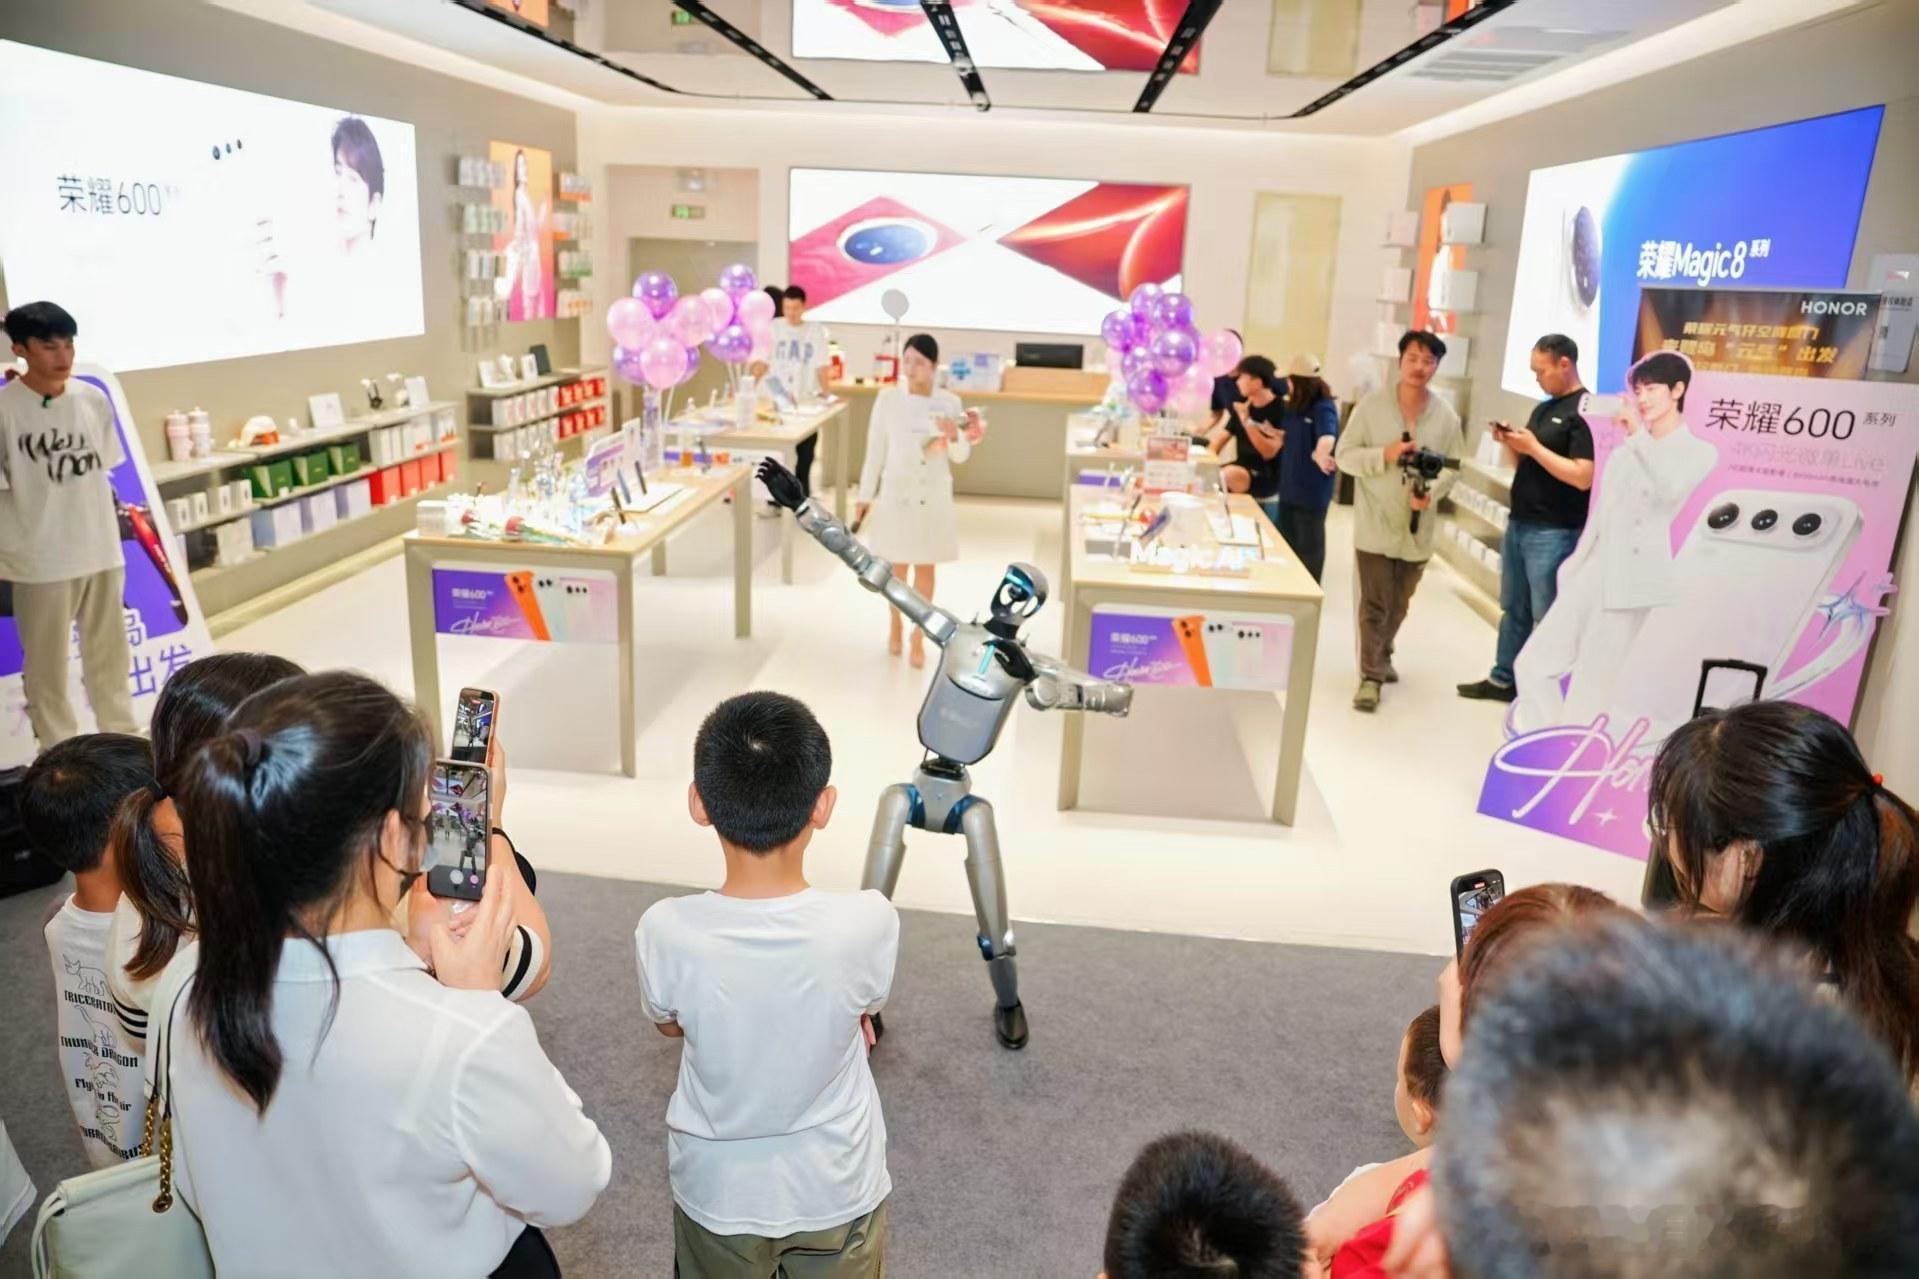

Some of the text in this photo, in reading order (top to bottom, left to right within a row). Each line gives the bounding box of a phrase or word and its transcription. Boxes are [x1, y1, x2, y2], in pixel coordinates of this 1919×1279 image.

[57, 174, 162, 216] 荣耀600
[1636, 239, 1746, 287] 荣耀Magic8
[1800, 300, 1868, 316] HONOR
[1704, 398, 1897, 440] 荣耀600 系列
[64, 990, 117, 1014] TRICERATO
